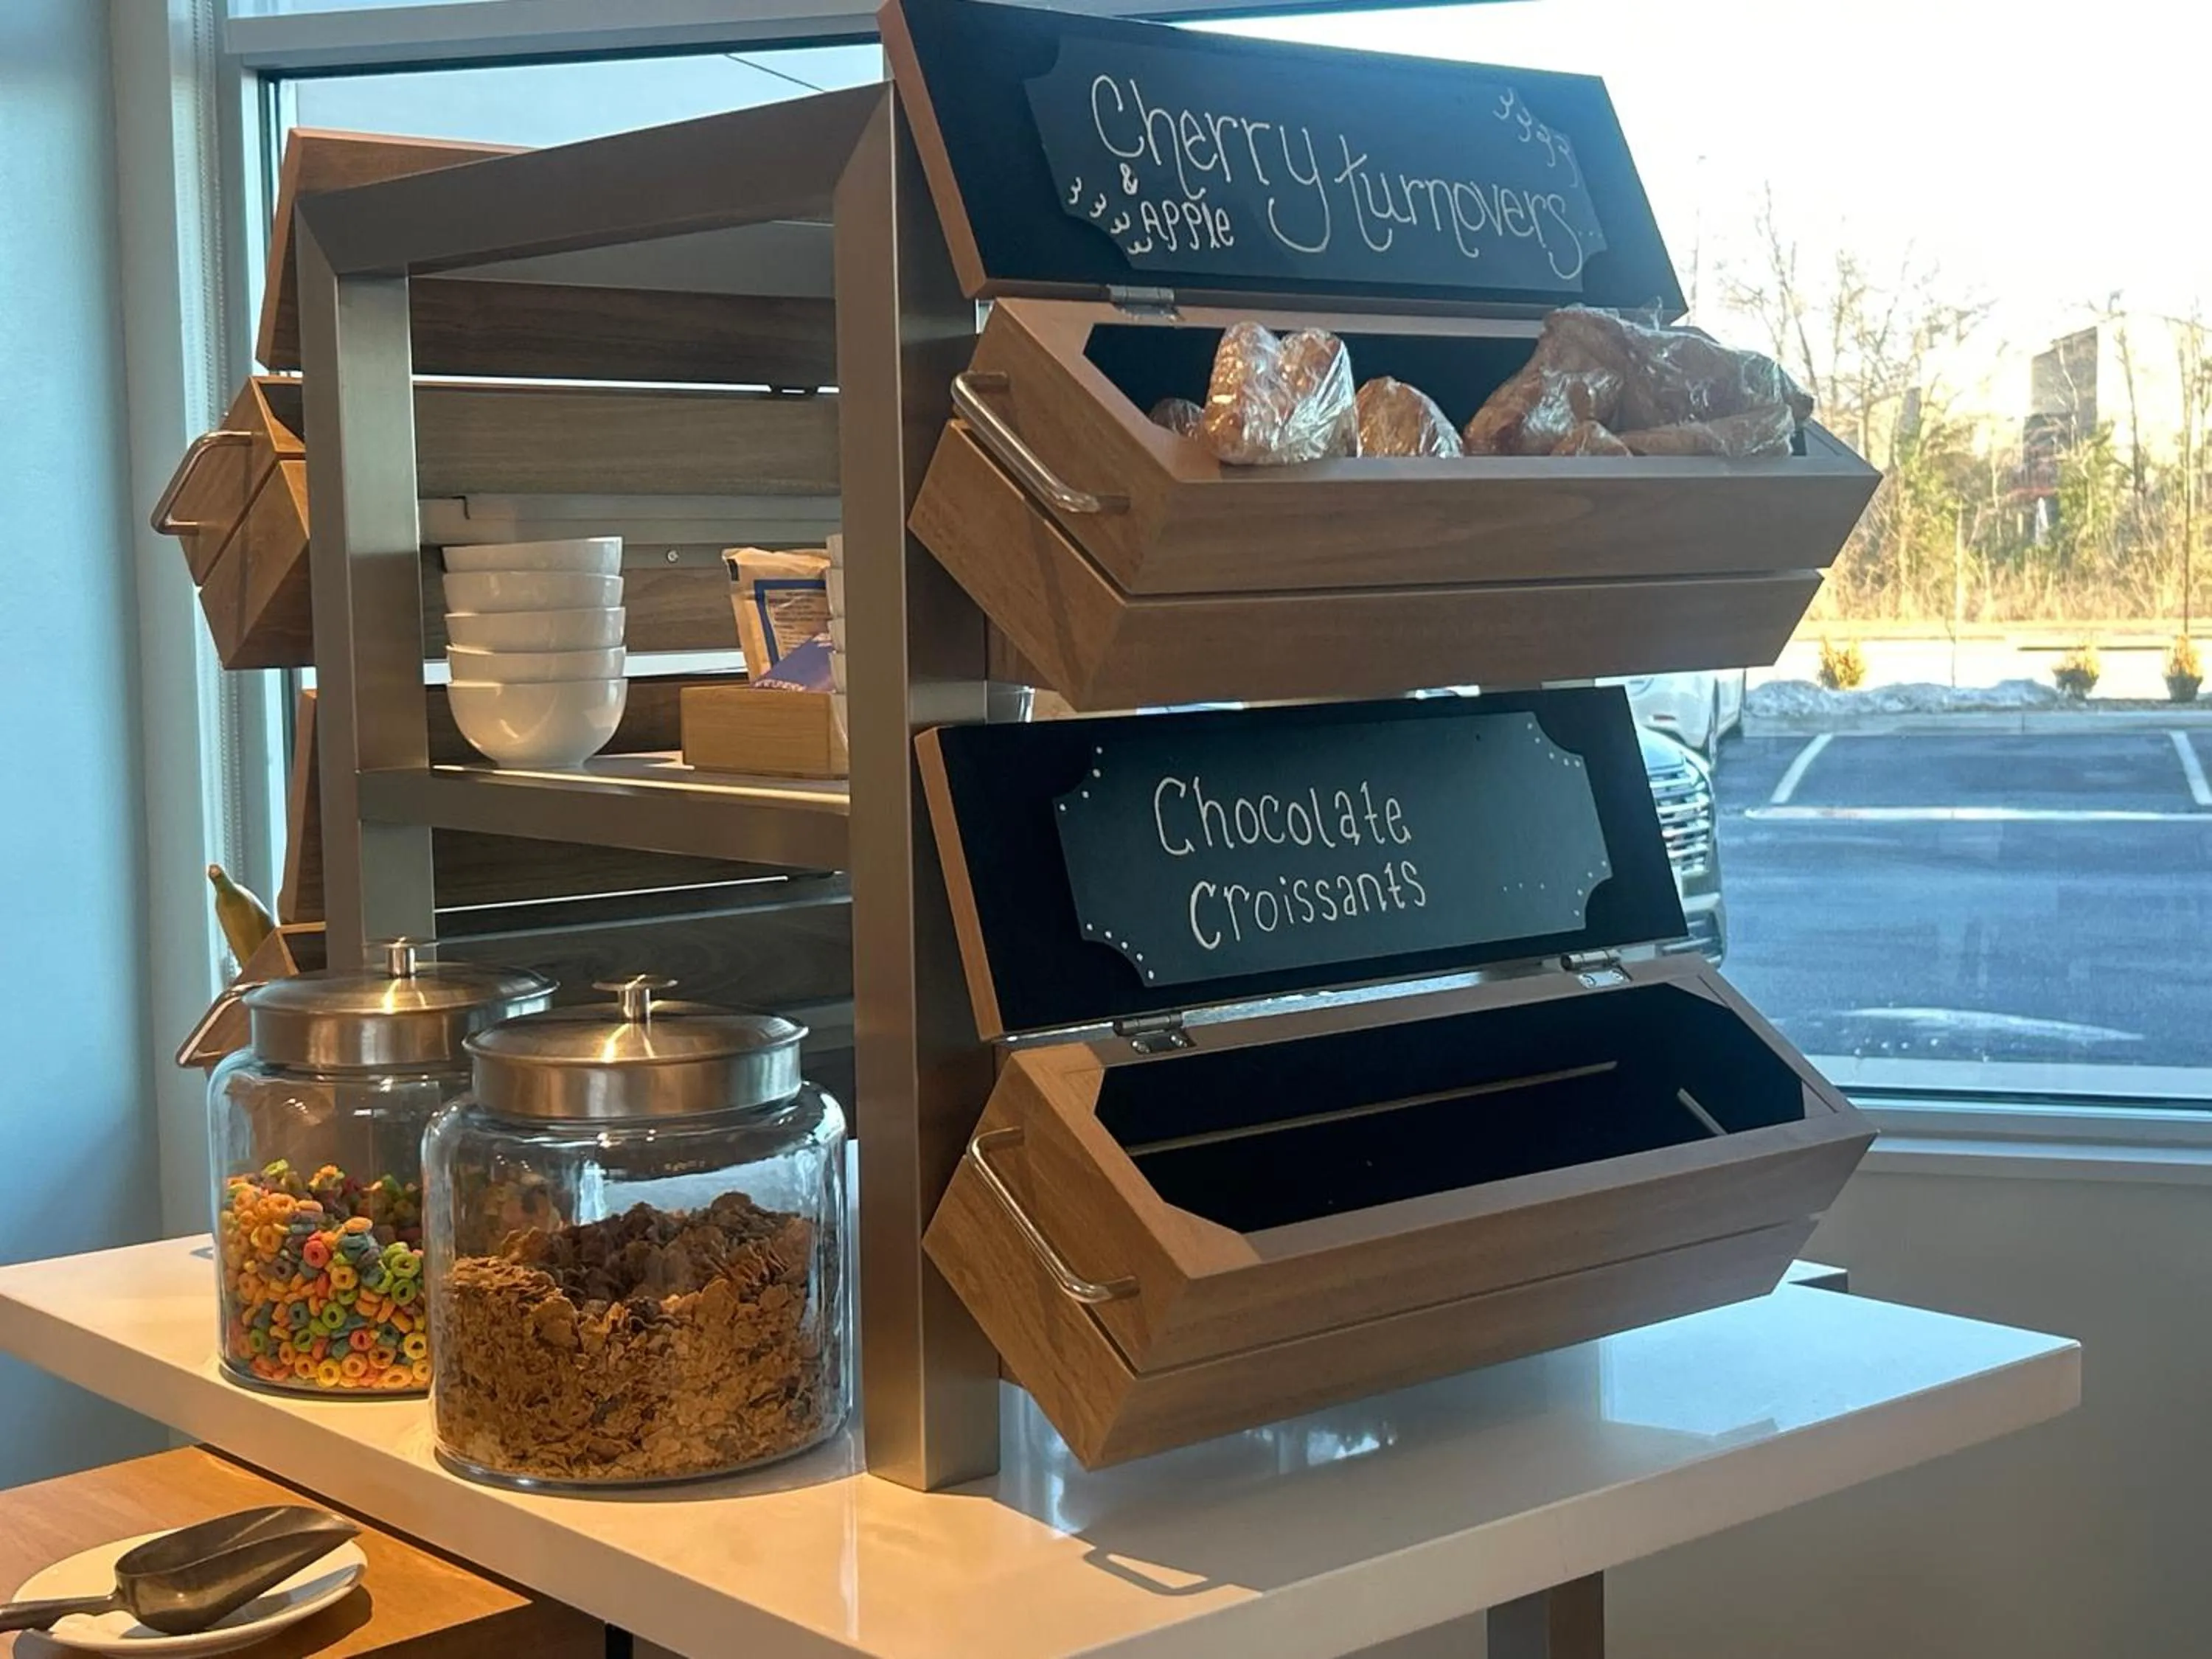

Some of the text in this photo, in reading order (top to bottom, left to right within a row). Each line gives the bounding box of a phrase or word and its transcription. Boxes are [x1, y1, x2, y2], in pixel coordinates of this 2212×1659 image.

[1091, 74, 1329, 253] Cherry
[1153, 776, 1411, 856] Chocolate
[1189, 861, 1427, 950] Croissants
